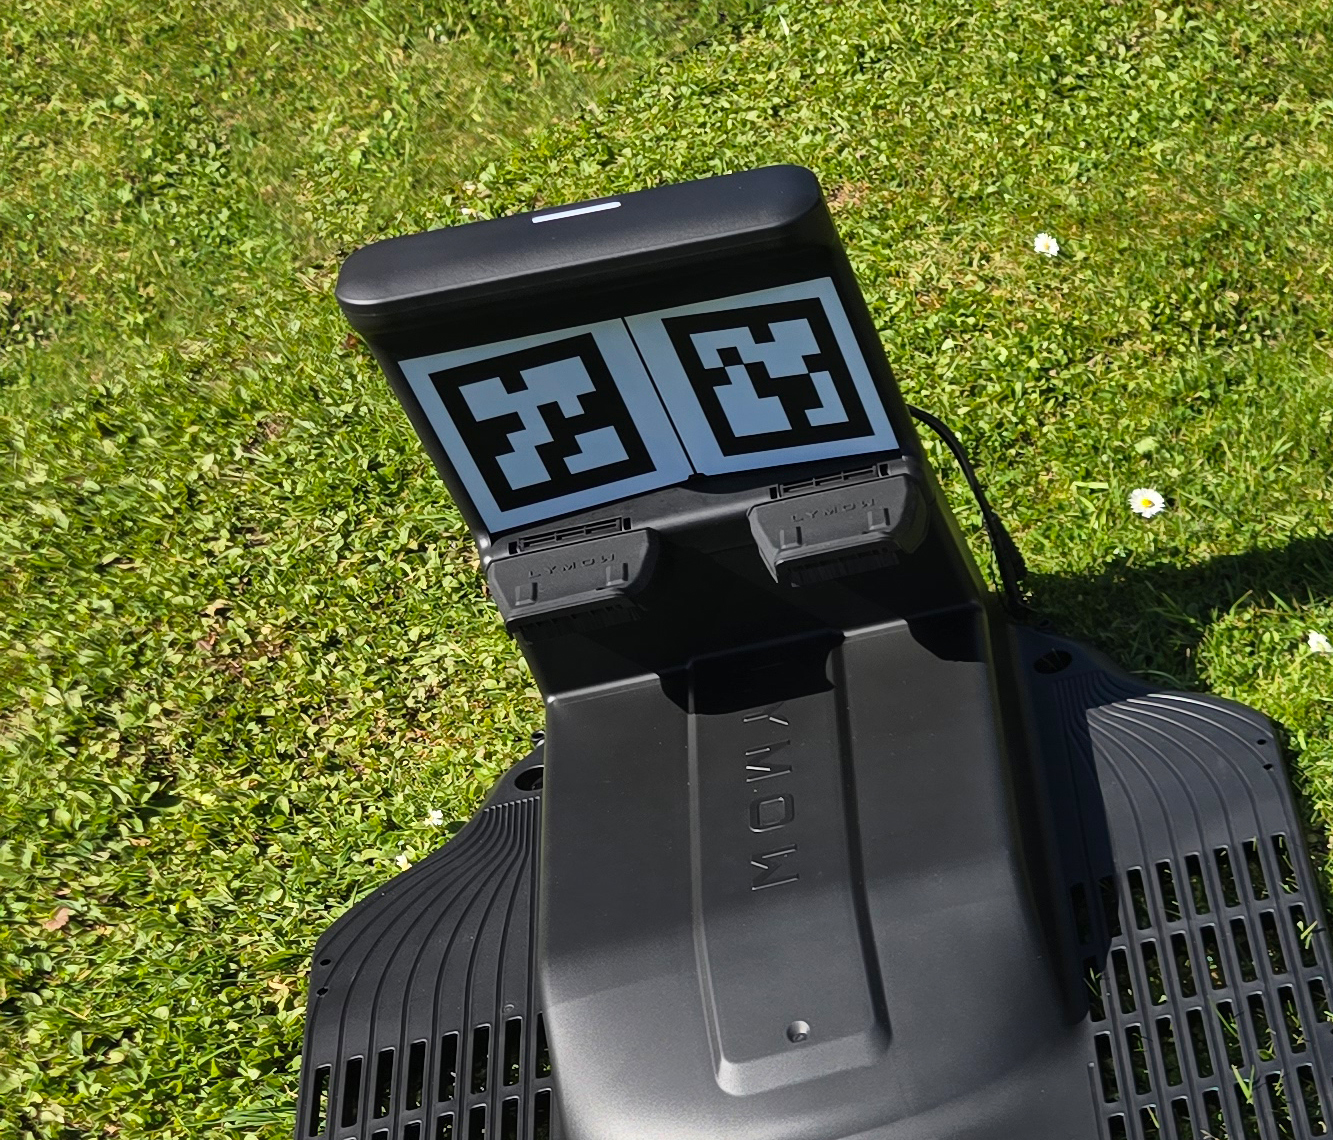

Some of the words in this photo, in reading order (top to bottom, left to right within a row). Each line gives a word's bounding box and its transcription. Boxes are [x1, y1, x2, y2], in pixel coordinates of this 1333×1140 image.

[790, 498, 876, 522] LYMOW
[528, 553, 615, 578] LYMOW
[742, 701, 799, 892] YMOW
